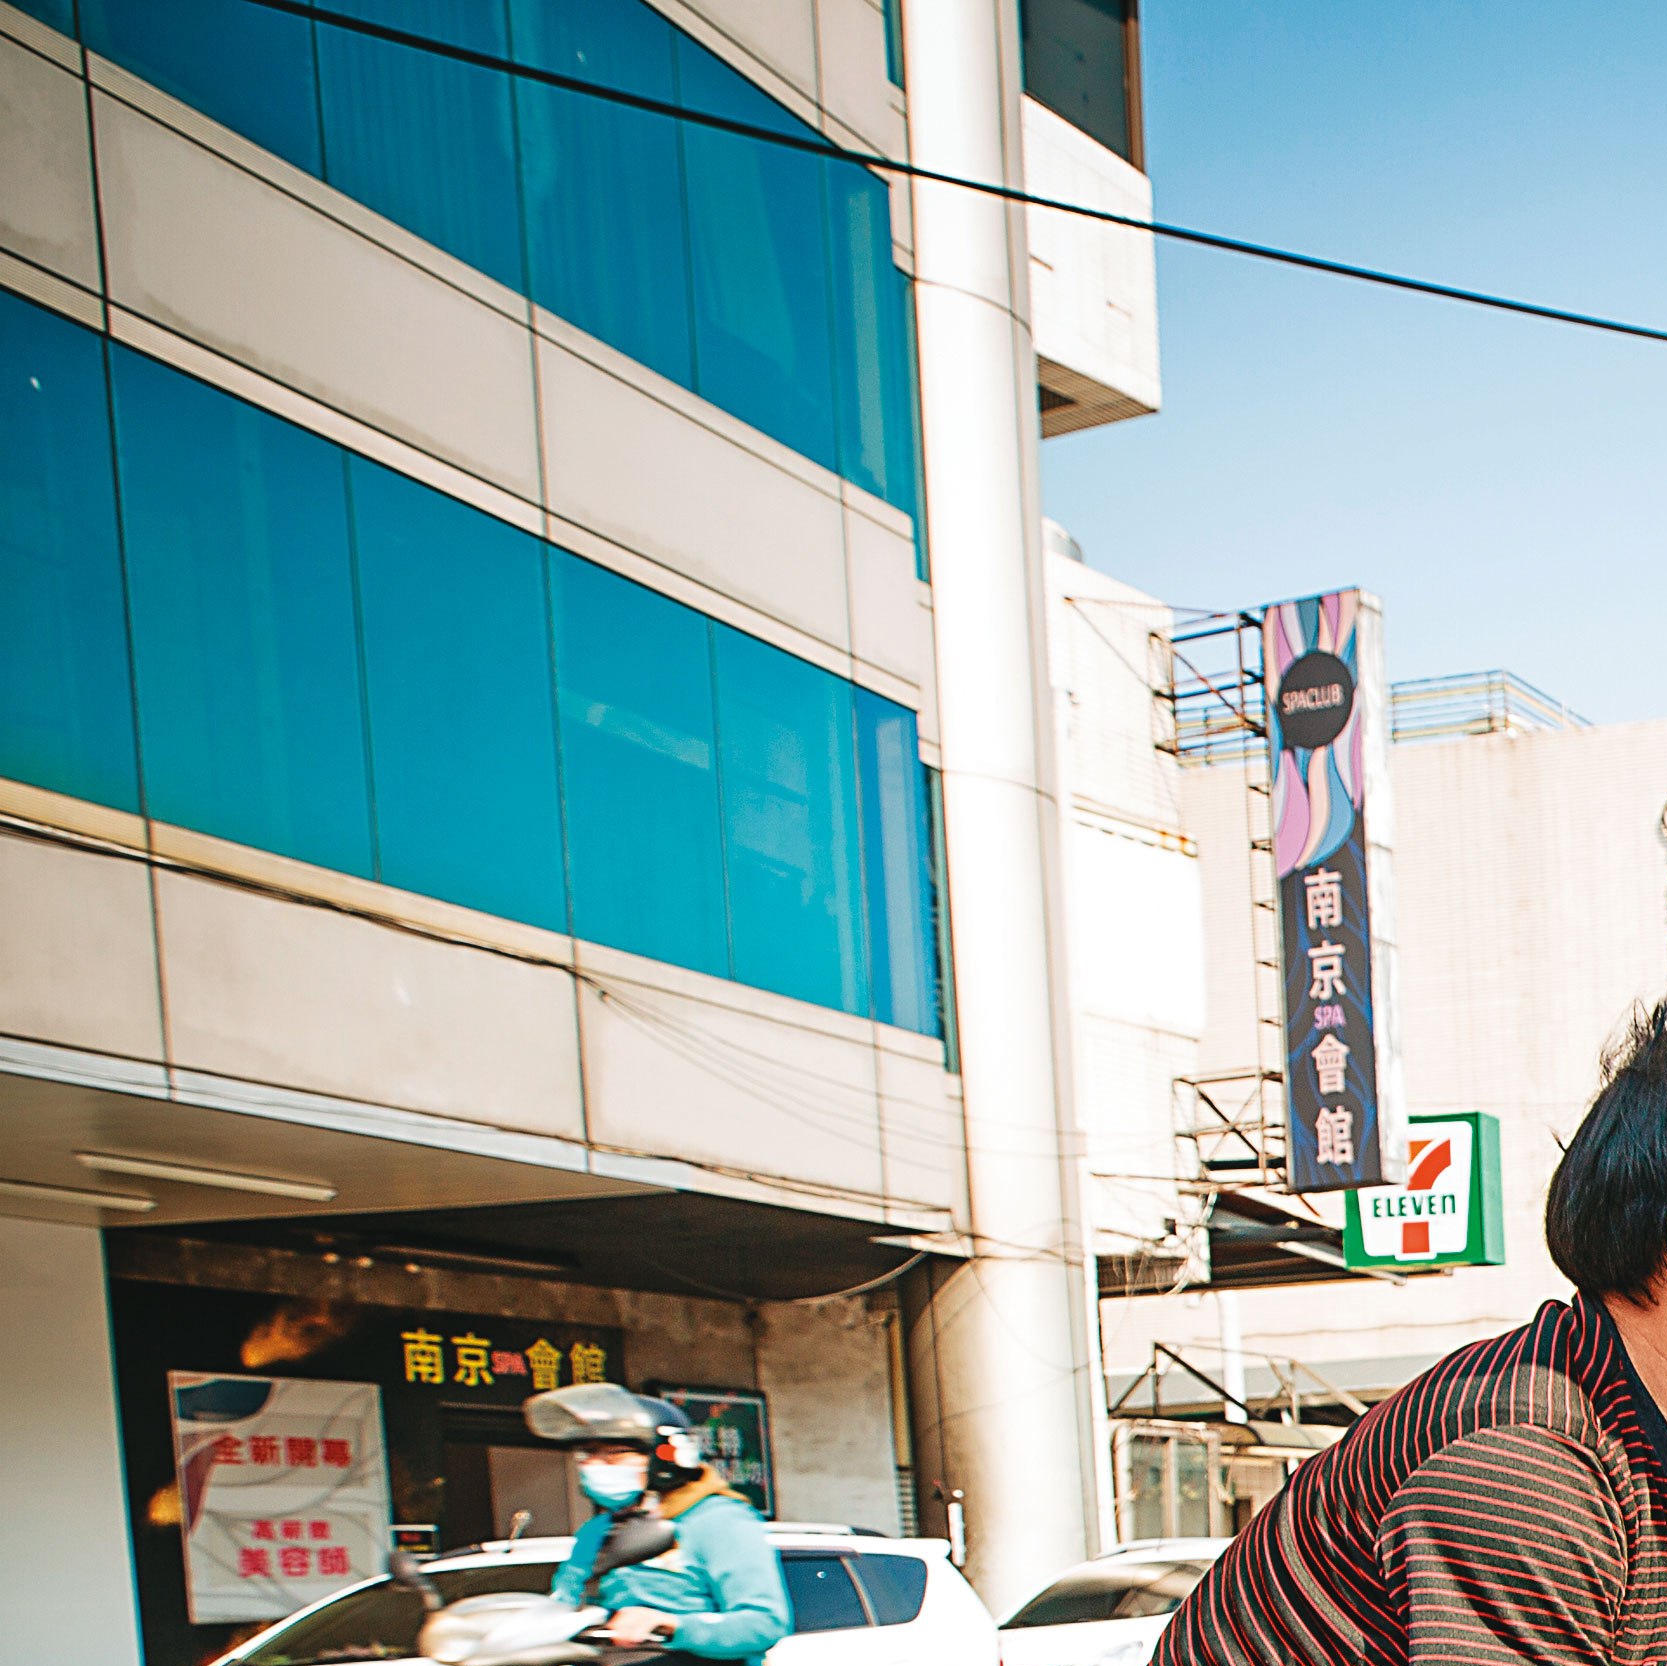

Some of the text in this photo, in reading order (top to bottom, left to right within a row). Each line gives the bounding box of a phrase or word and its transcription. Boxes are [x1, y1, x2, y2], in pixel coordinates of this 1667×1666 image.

[1304, 868, 1355, 1166] 南京 SPA 會館
[401, 1328, 494, 1386] 南京
[525, 1338, 607, 1390] 會館
[212, 1435, 351, 1468] 全新開幕
[238, 1546, 351, 1578] 美容師
